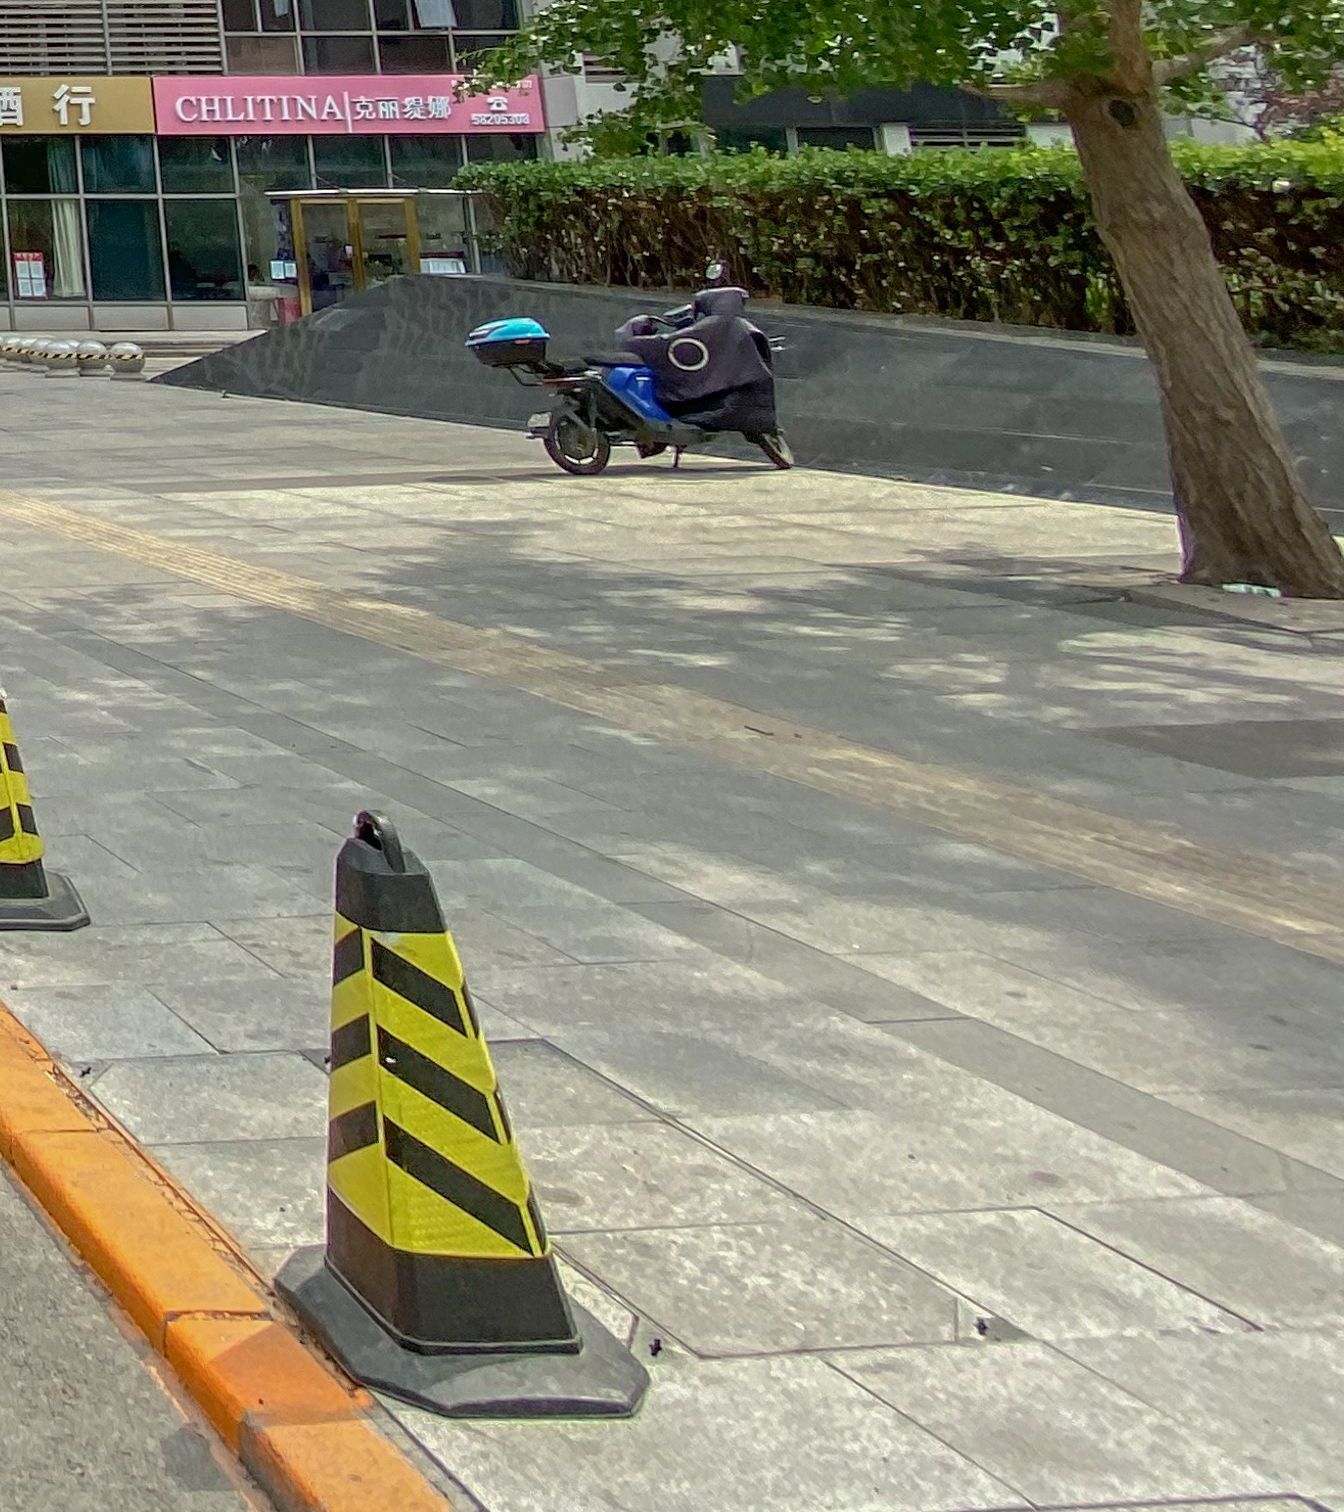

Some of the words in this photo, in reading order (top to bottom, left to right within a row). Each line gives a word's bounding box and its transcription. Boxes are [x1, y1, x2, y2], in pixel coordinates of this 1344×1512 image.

[175, 95, 345, 122] CHLITINA
[351, 95, 451, 121] 克丽缇娜
